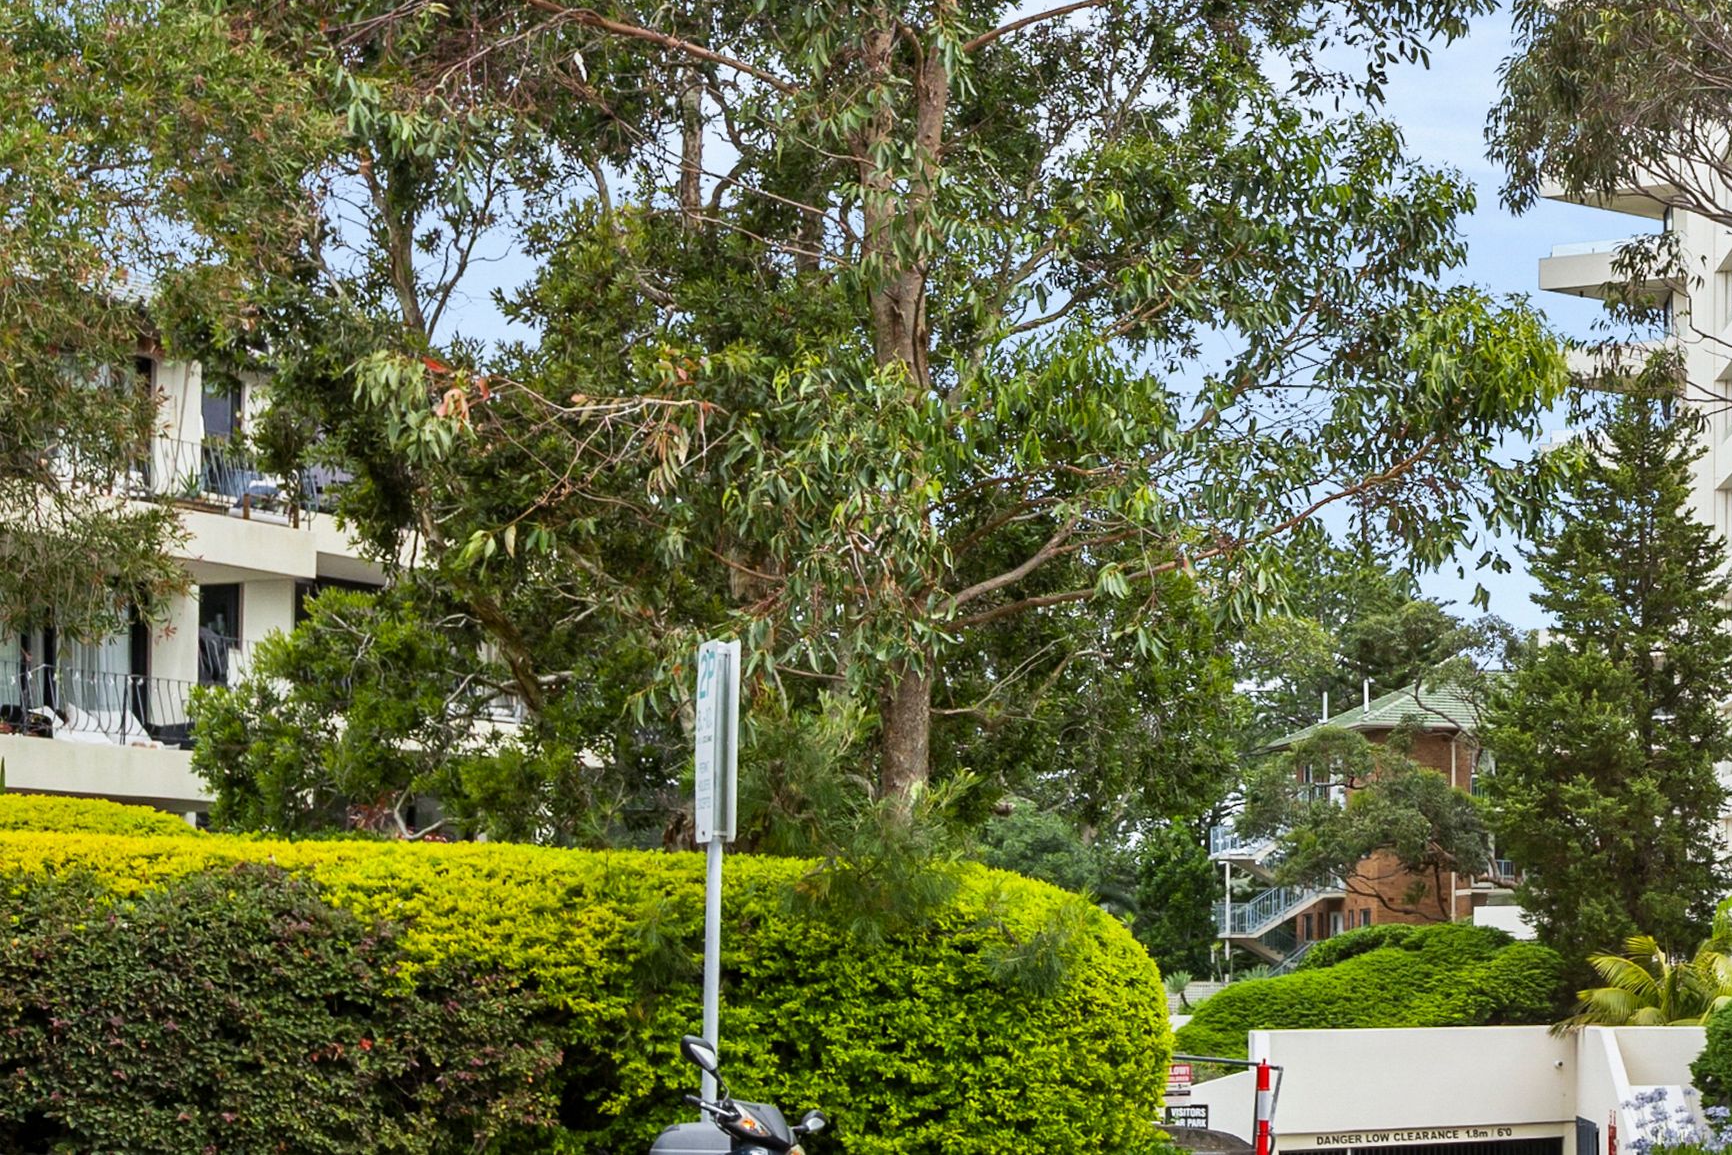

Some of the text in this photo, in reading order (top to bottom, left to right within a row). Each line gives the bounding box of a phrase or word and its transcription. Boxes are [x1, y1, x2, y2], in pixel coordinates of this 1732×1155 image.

[699, 651, 715, 699] 2P
[1170, 1107, 1207, 1117] VISITORS
[1187, 1118, 1207, 1128] PARK
[1316, 1134, 1362, 1145] DANGER
[1366, 1132, 1390, 1143] LOW
[1394, 1130, 1459, 1142] CLEARANCE
[1465, 1129, 1488, 1139] 1.8m
